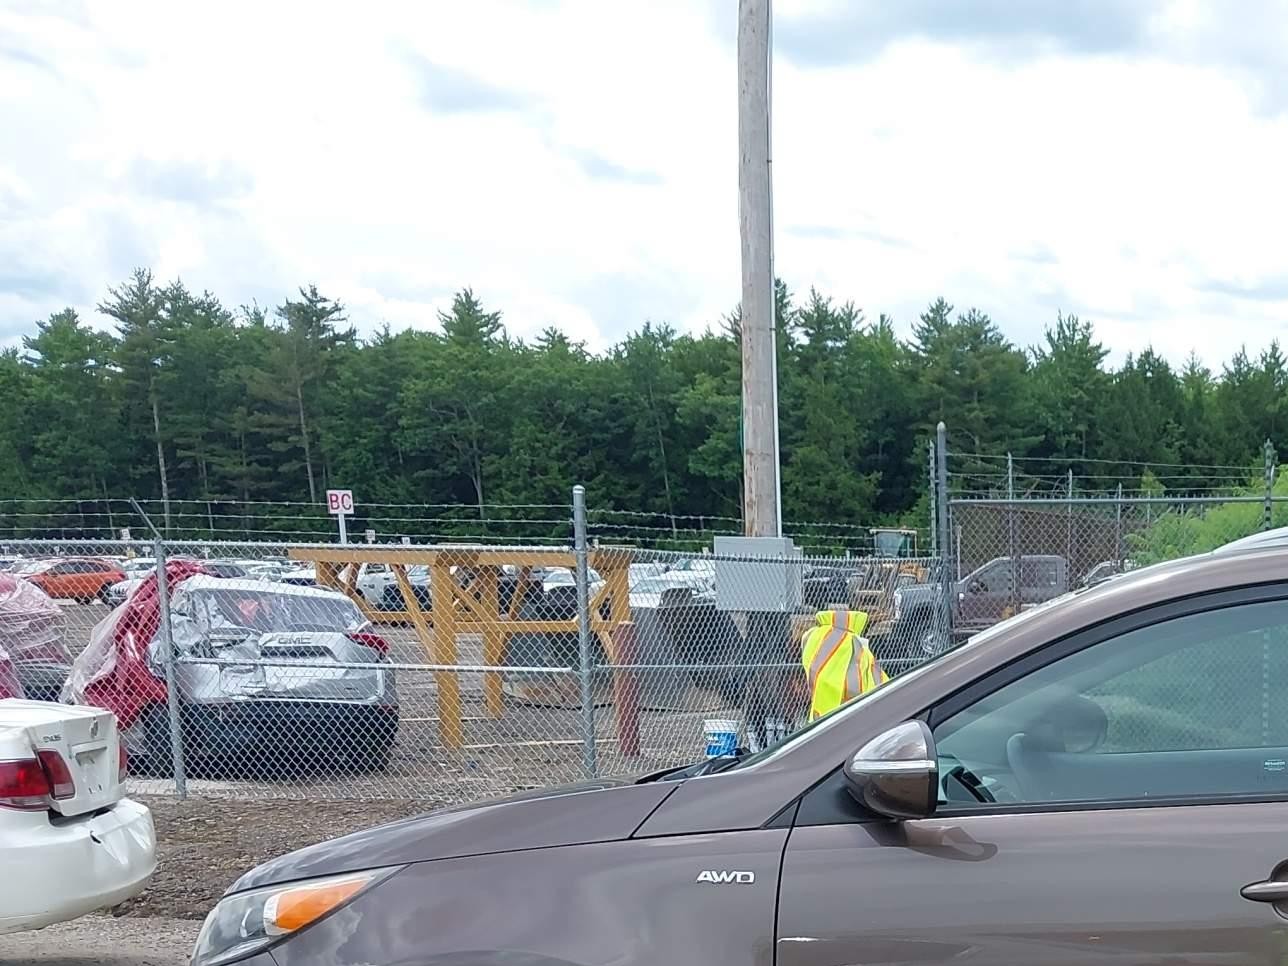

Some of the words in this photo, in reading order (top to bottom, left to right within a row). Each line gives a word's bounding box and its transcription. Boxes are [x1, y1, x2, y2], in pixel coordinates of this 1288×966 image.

[329, 493, 352, 510] BC
[278, 636, 312, 645] GMC
[696, 870, 755, 883] AWD
